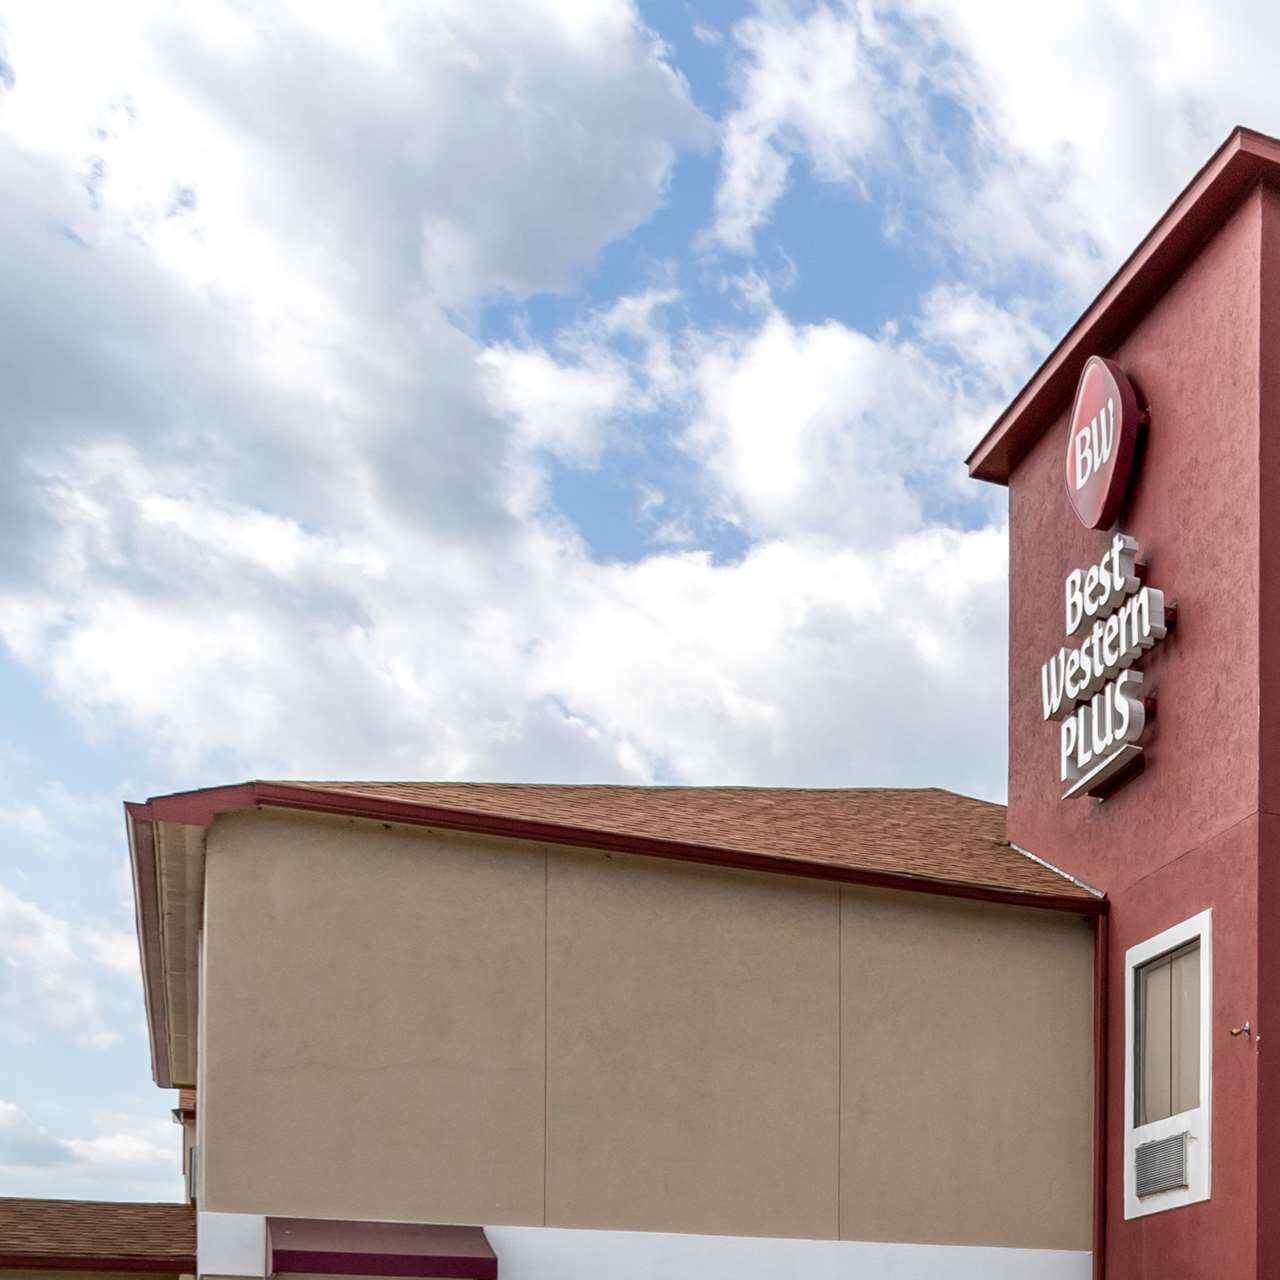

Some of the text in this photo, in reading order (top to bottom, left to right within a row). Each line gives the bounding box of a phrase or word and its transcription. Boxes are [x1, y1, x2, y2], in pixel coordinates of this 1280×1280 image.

[1073, 398, 1116, 491] BW
[1065, 533, 1126, 636] Best
[1041, 587, 1152, 721] Western
[1060, 668, 1136, 782] PLUS
